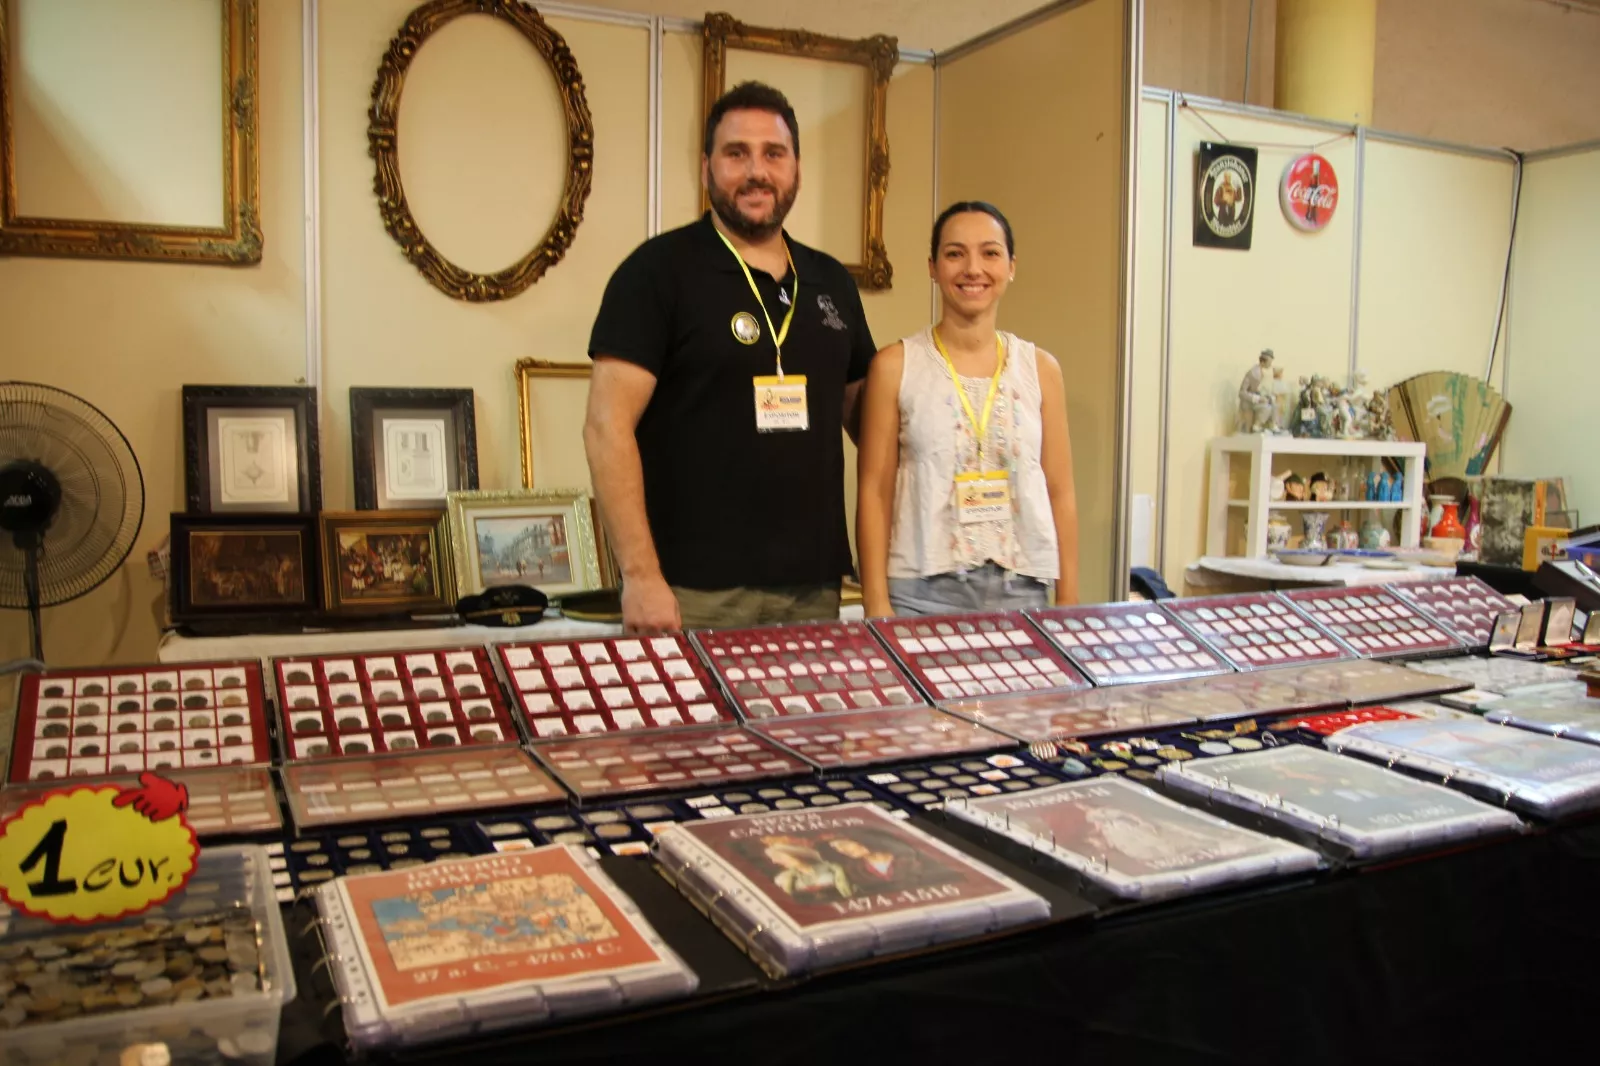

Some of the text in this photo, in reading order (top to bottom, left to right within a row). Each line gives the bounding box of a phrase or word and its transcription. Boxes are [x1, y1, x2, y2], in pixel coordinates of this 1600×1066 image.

[19, 818, 174, 898] 1 eur.
[407, 864, 533, 890] ROMANO
